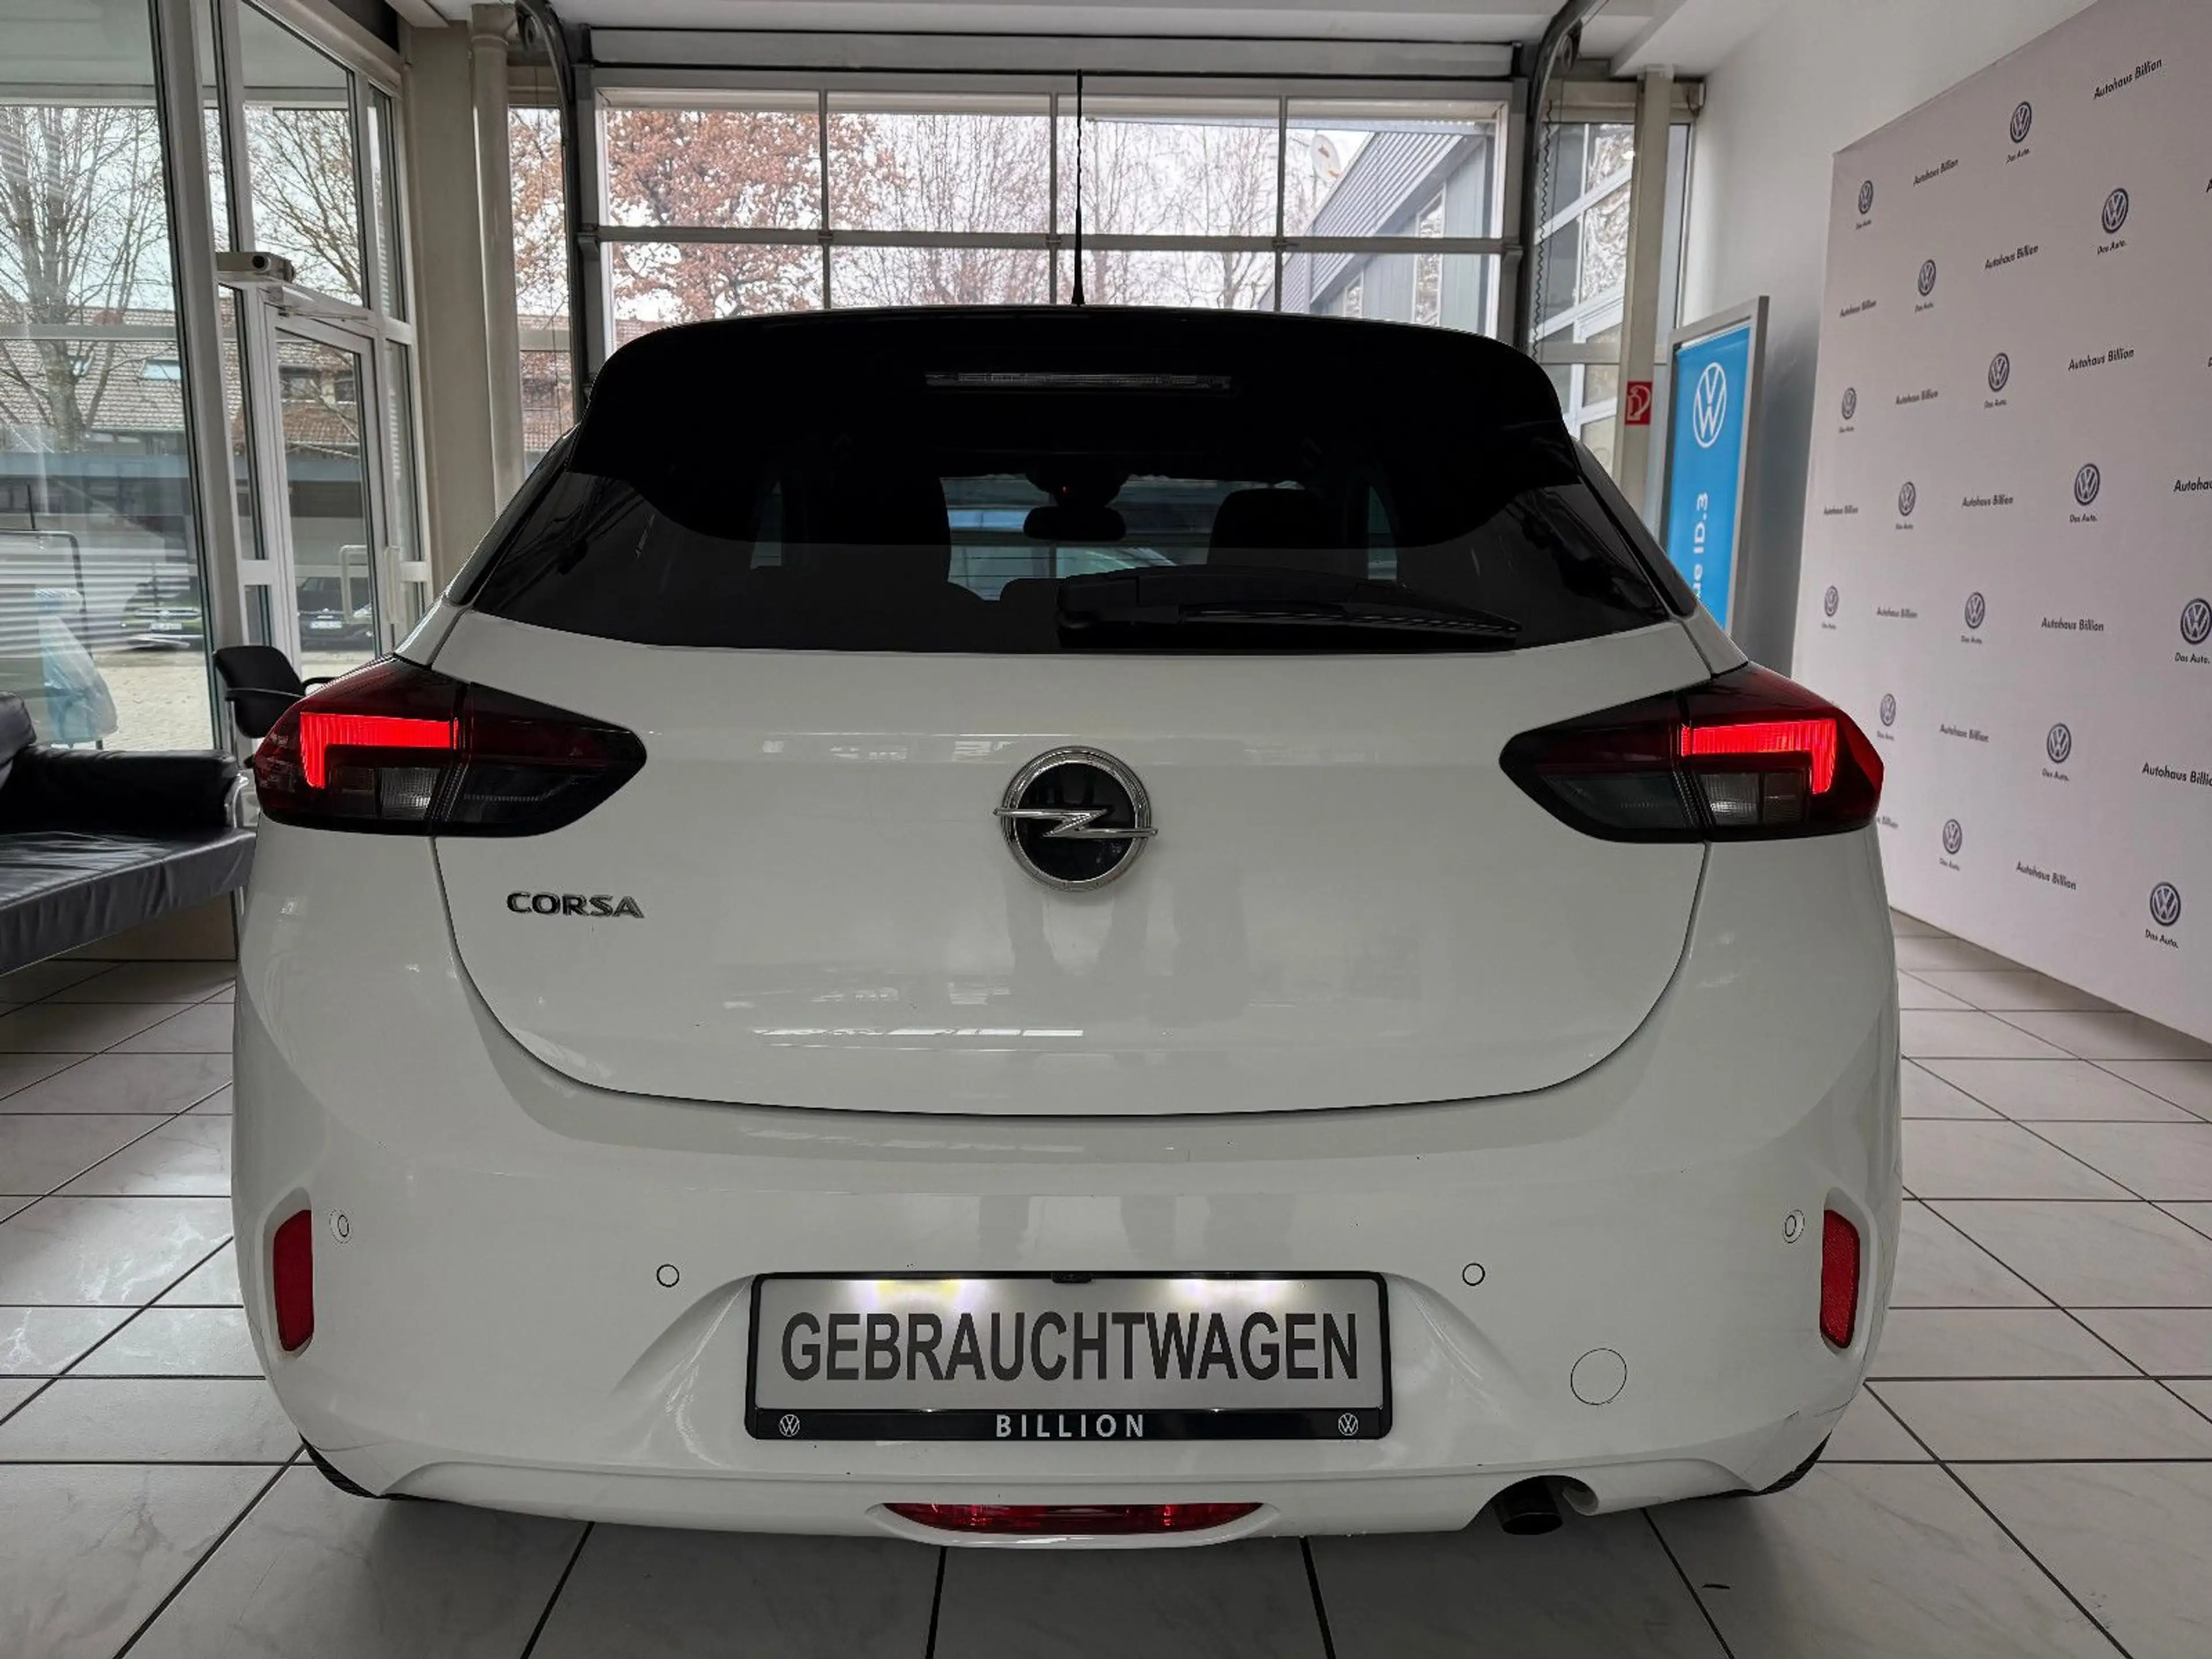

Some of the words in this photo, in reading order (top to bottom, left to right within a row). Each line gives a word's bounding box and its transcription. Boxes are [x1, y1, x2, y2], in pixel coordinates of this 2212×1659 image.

[2093, 74, 2133, 100] Autohaus
[2134, 59, 2162, 79] Billion
[2068, 354, 2105, 371] Autohaus
[2108, 347, 2134, 362] Billion
[1694, 492, 1709, 554] ID.3
[2041, 616, 2076, 630] Autohaus
[2079, 618, 2104, 631] Billion
[2175, 652, 2188, 662] Das
[2142, 762, 2187, 782] Autohaus
[2190, 770, 2212, 786] Billio
[507, 892, 645, 919] CORSA
[2145, 929, 2158, 941] Das
[781, 1311, 1358, 1381] GEBRAUCHTWAGEN
[995, 1414, 1143, 1438] BILLION
